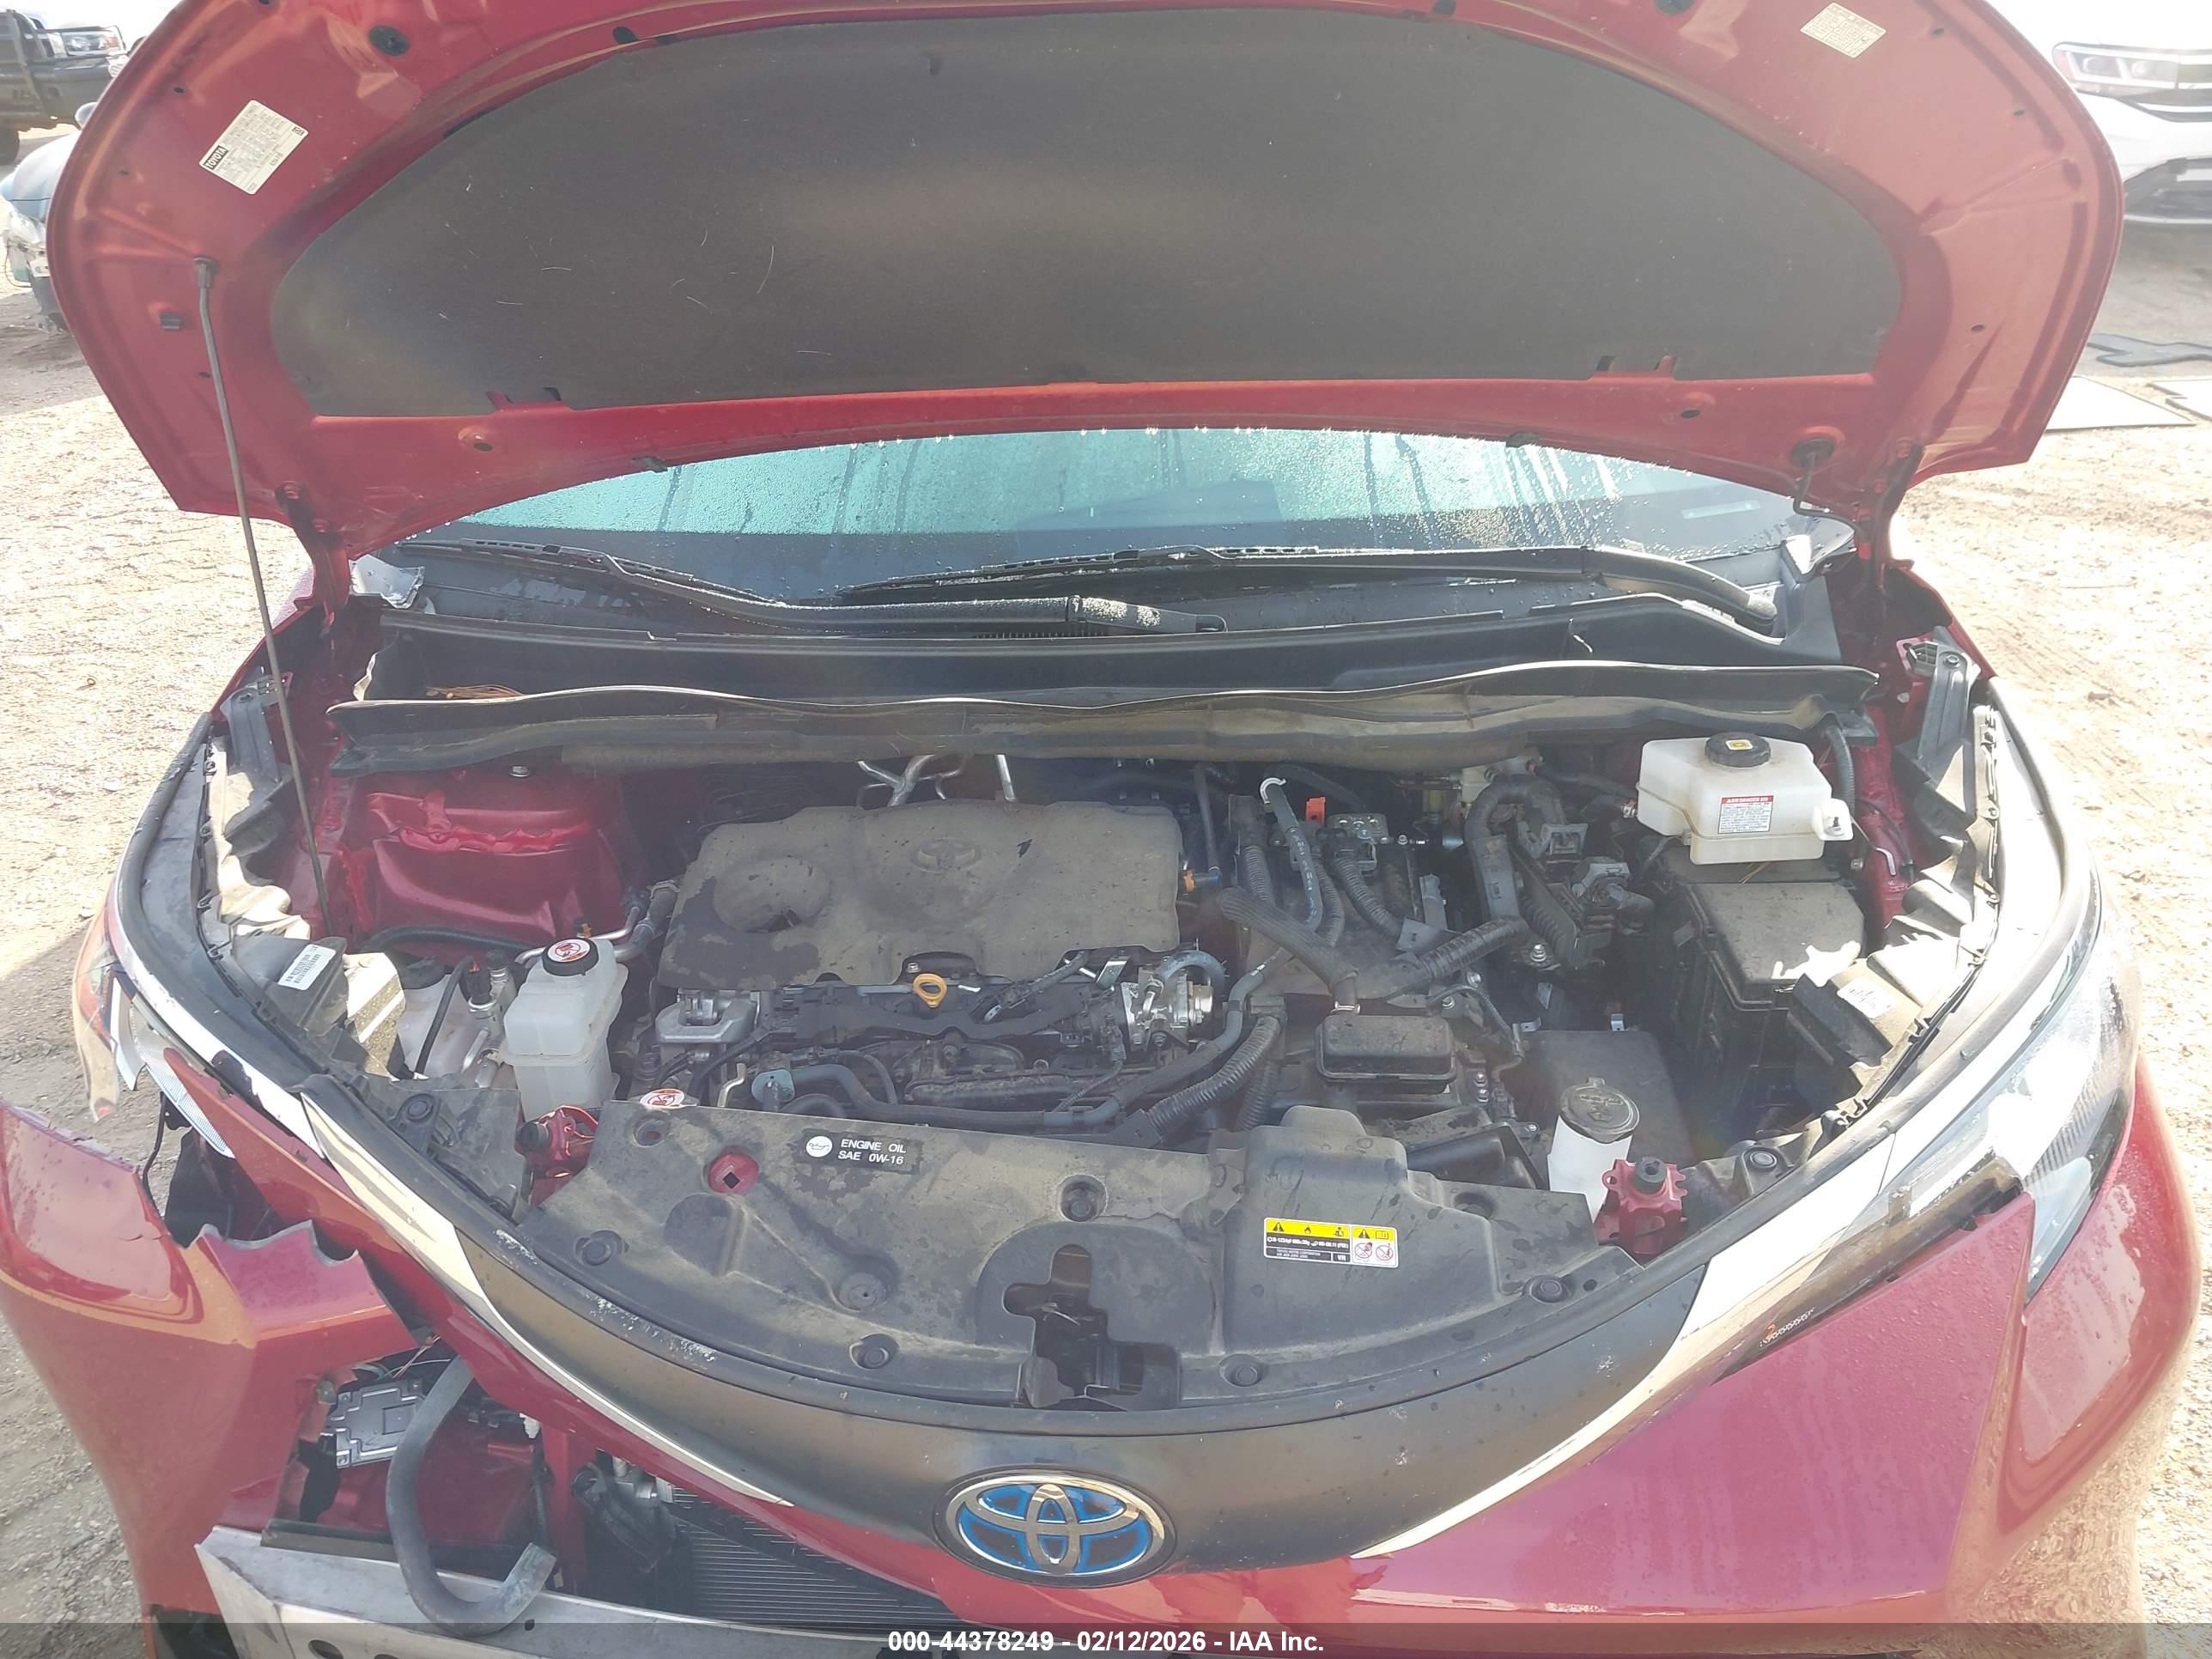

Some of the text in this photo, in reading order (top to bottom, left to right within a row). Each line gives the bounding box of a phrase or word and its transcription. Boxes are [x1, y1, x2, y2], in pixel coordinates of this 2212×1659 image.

[204, 147, 228, 169] TOYOTA
[841, 1139, 907, 1153] ENGINE OIL
[837, 1150, 904, 1165] SAE 0W-16
